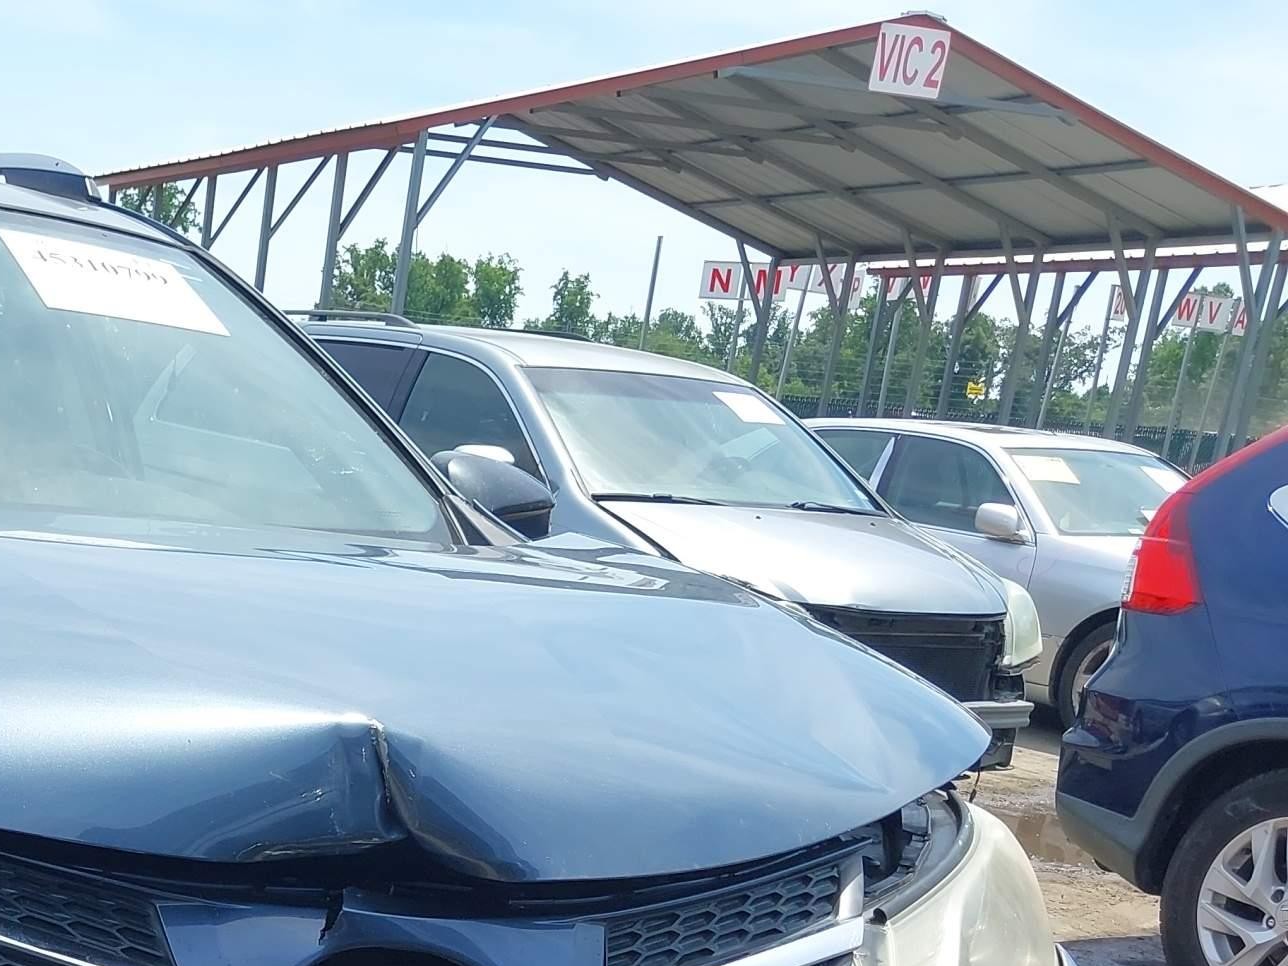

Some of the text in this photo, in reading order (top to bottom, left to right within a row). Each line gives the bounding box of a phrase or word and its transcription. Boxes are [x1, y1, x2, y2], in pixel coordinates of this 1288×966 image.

[878, 31, 946, 89] VIC 2
[709, 268, 732, 294] N
[1177, 298, 1198, 321] W
[1209, 301, 1223, 324] V
